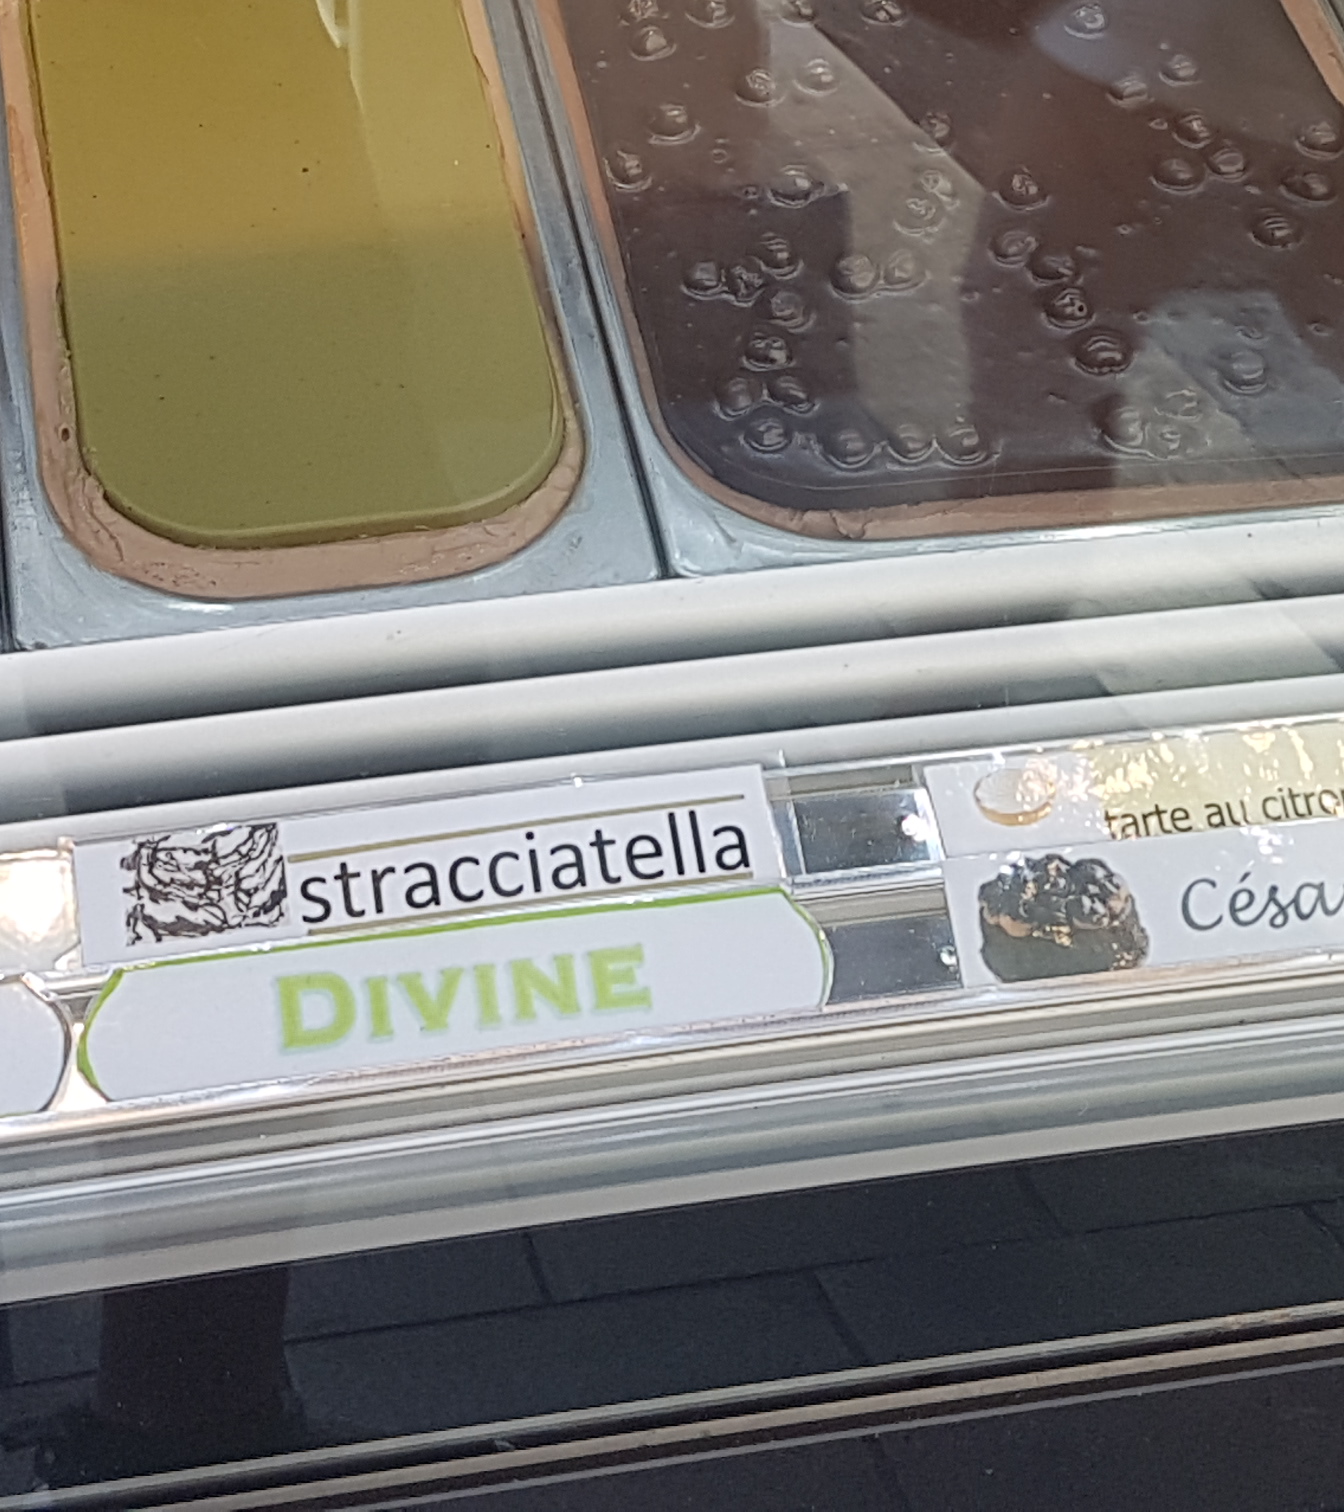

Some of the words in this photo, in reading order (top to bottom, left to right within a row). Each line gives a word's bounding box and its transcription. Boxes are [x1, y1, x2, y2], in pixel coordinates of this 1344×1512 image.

[300, 809, 753, 925] stracciatella
[1105, 803, 1194, 840] tarte
[273, 941, 654, 1055] DIVINE
